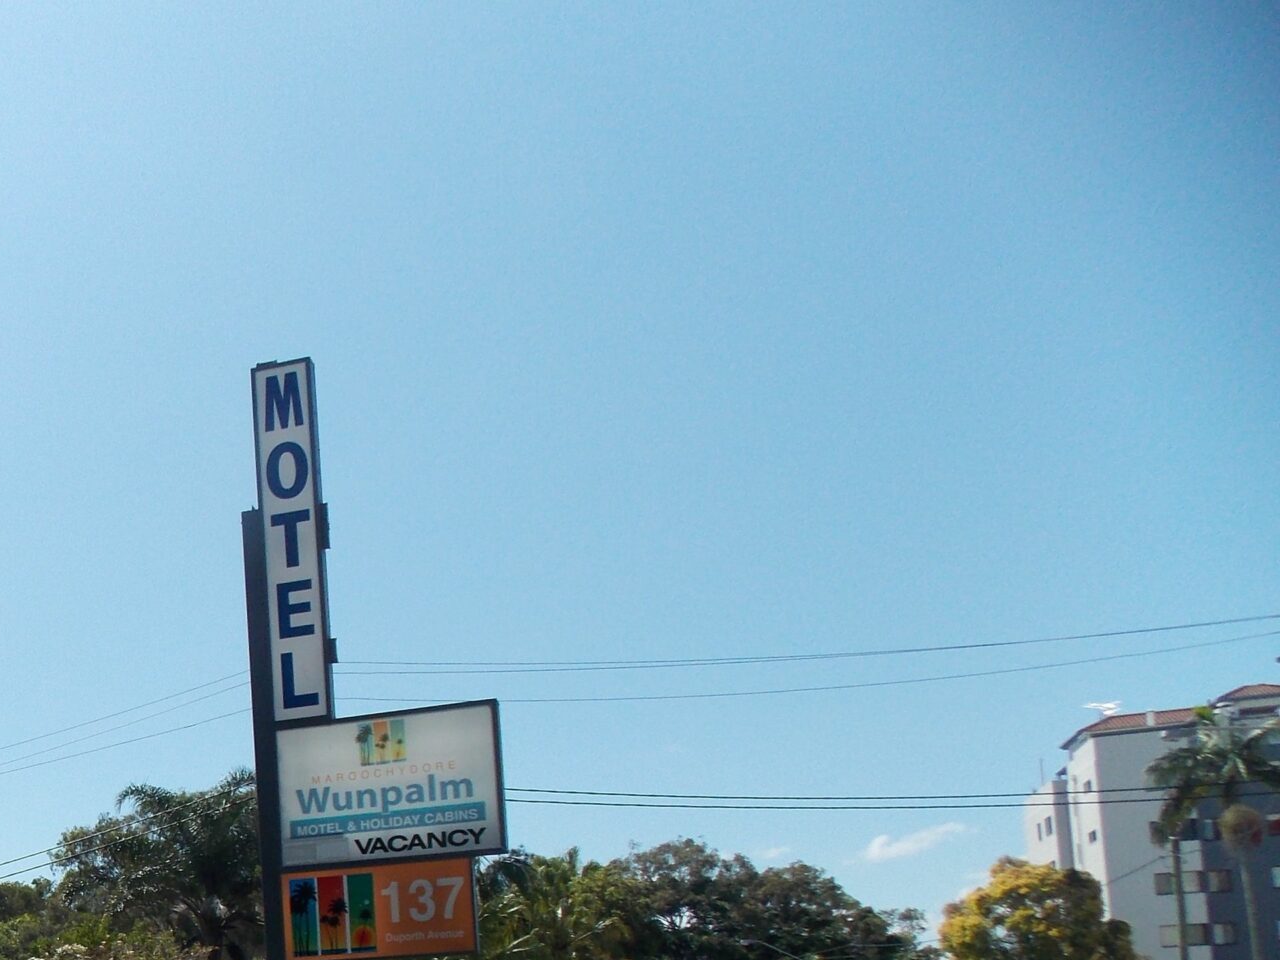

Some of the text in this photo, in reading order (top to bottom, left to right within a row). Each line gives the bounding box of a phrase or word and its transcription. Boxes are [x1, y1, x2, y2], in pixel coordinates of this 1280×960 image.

[265, 371, 319, 709] MOTEL
[296, 774, 474, 813] Wunpalm
[297, 809, 478, 836] MOTEL & HOLIDAY CABINS
[354, 827, 486, 855] VACANCY
[381, 876, 464, 923] 137
[427, 929, 464, 940] Avenue
